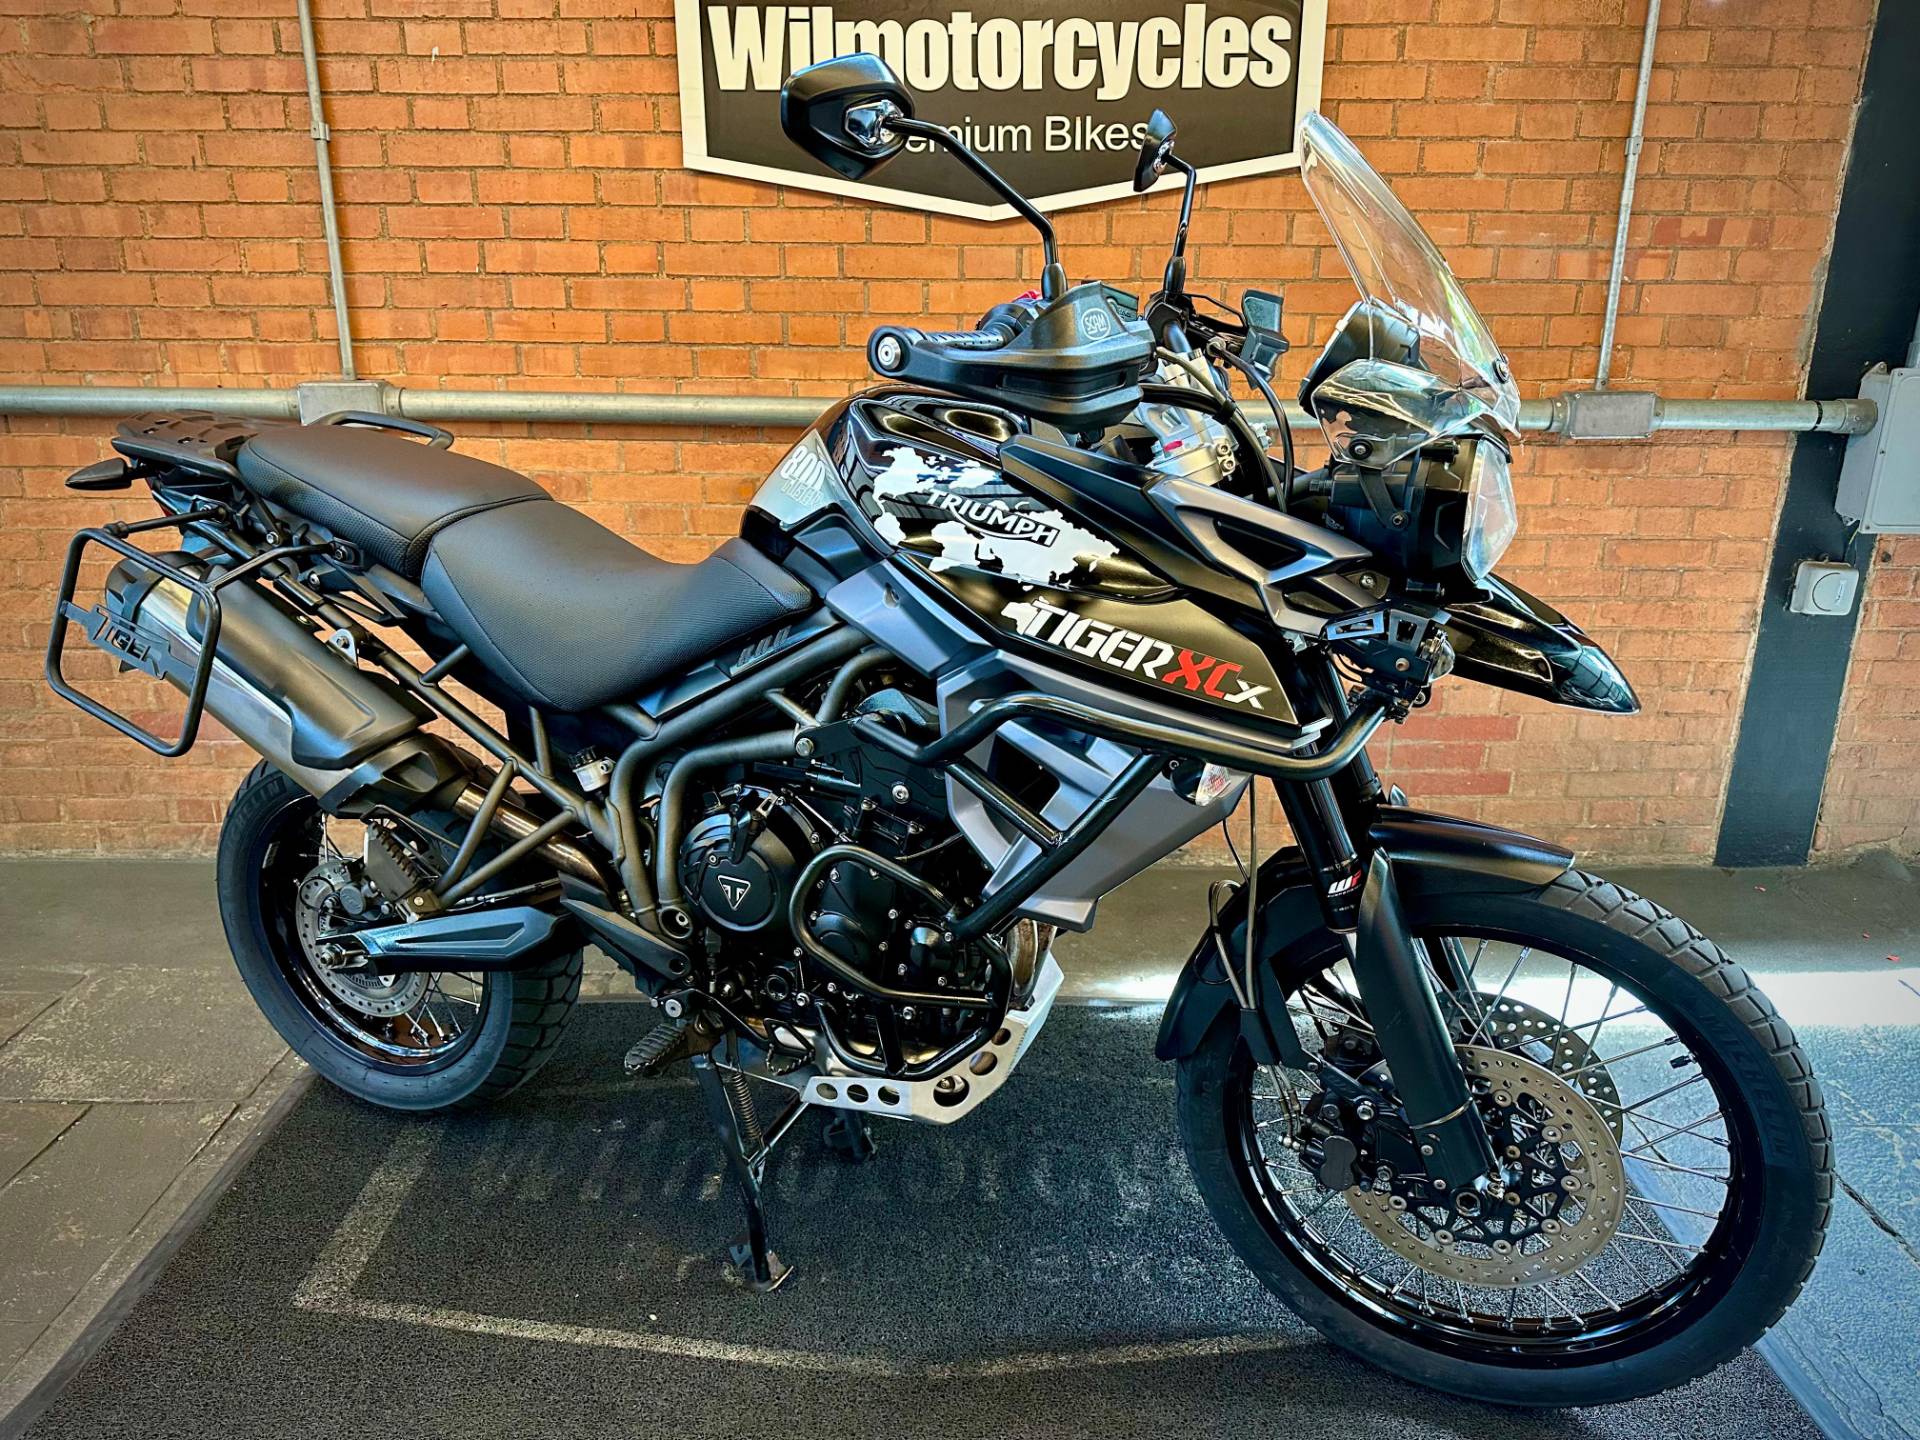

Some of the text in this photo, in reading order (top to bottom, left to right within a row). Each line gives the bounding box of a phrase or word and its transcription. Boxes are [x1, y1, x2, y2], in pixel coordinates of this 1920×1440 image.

[707, 3, 1292, 101] Wilmotorcycles
[926, 488, 1058, 547] TRIUMPH
[1024, 599, 1175, 680] TIGER
[1701, 1013, 1793, 1161] MICHELIN
